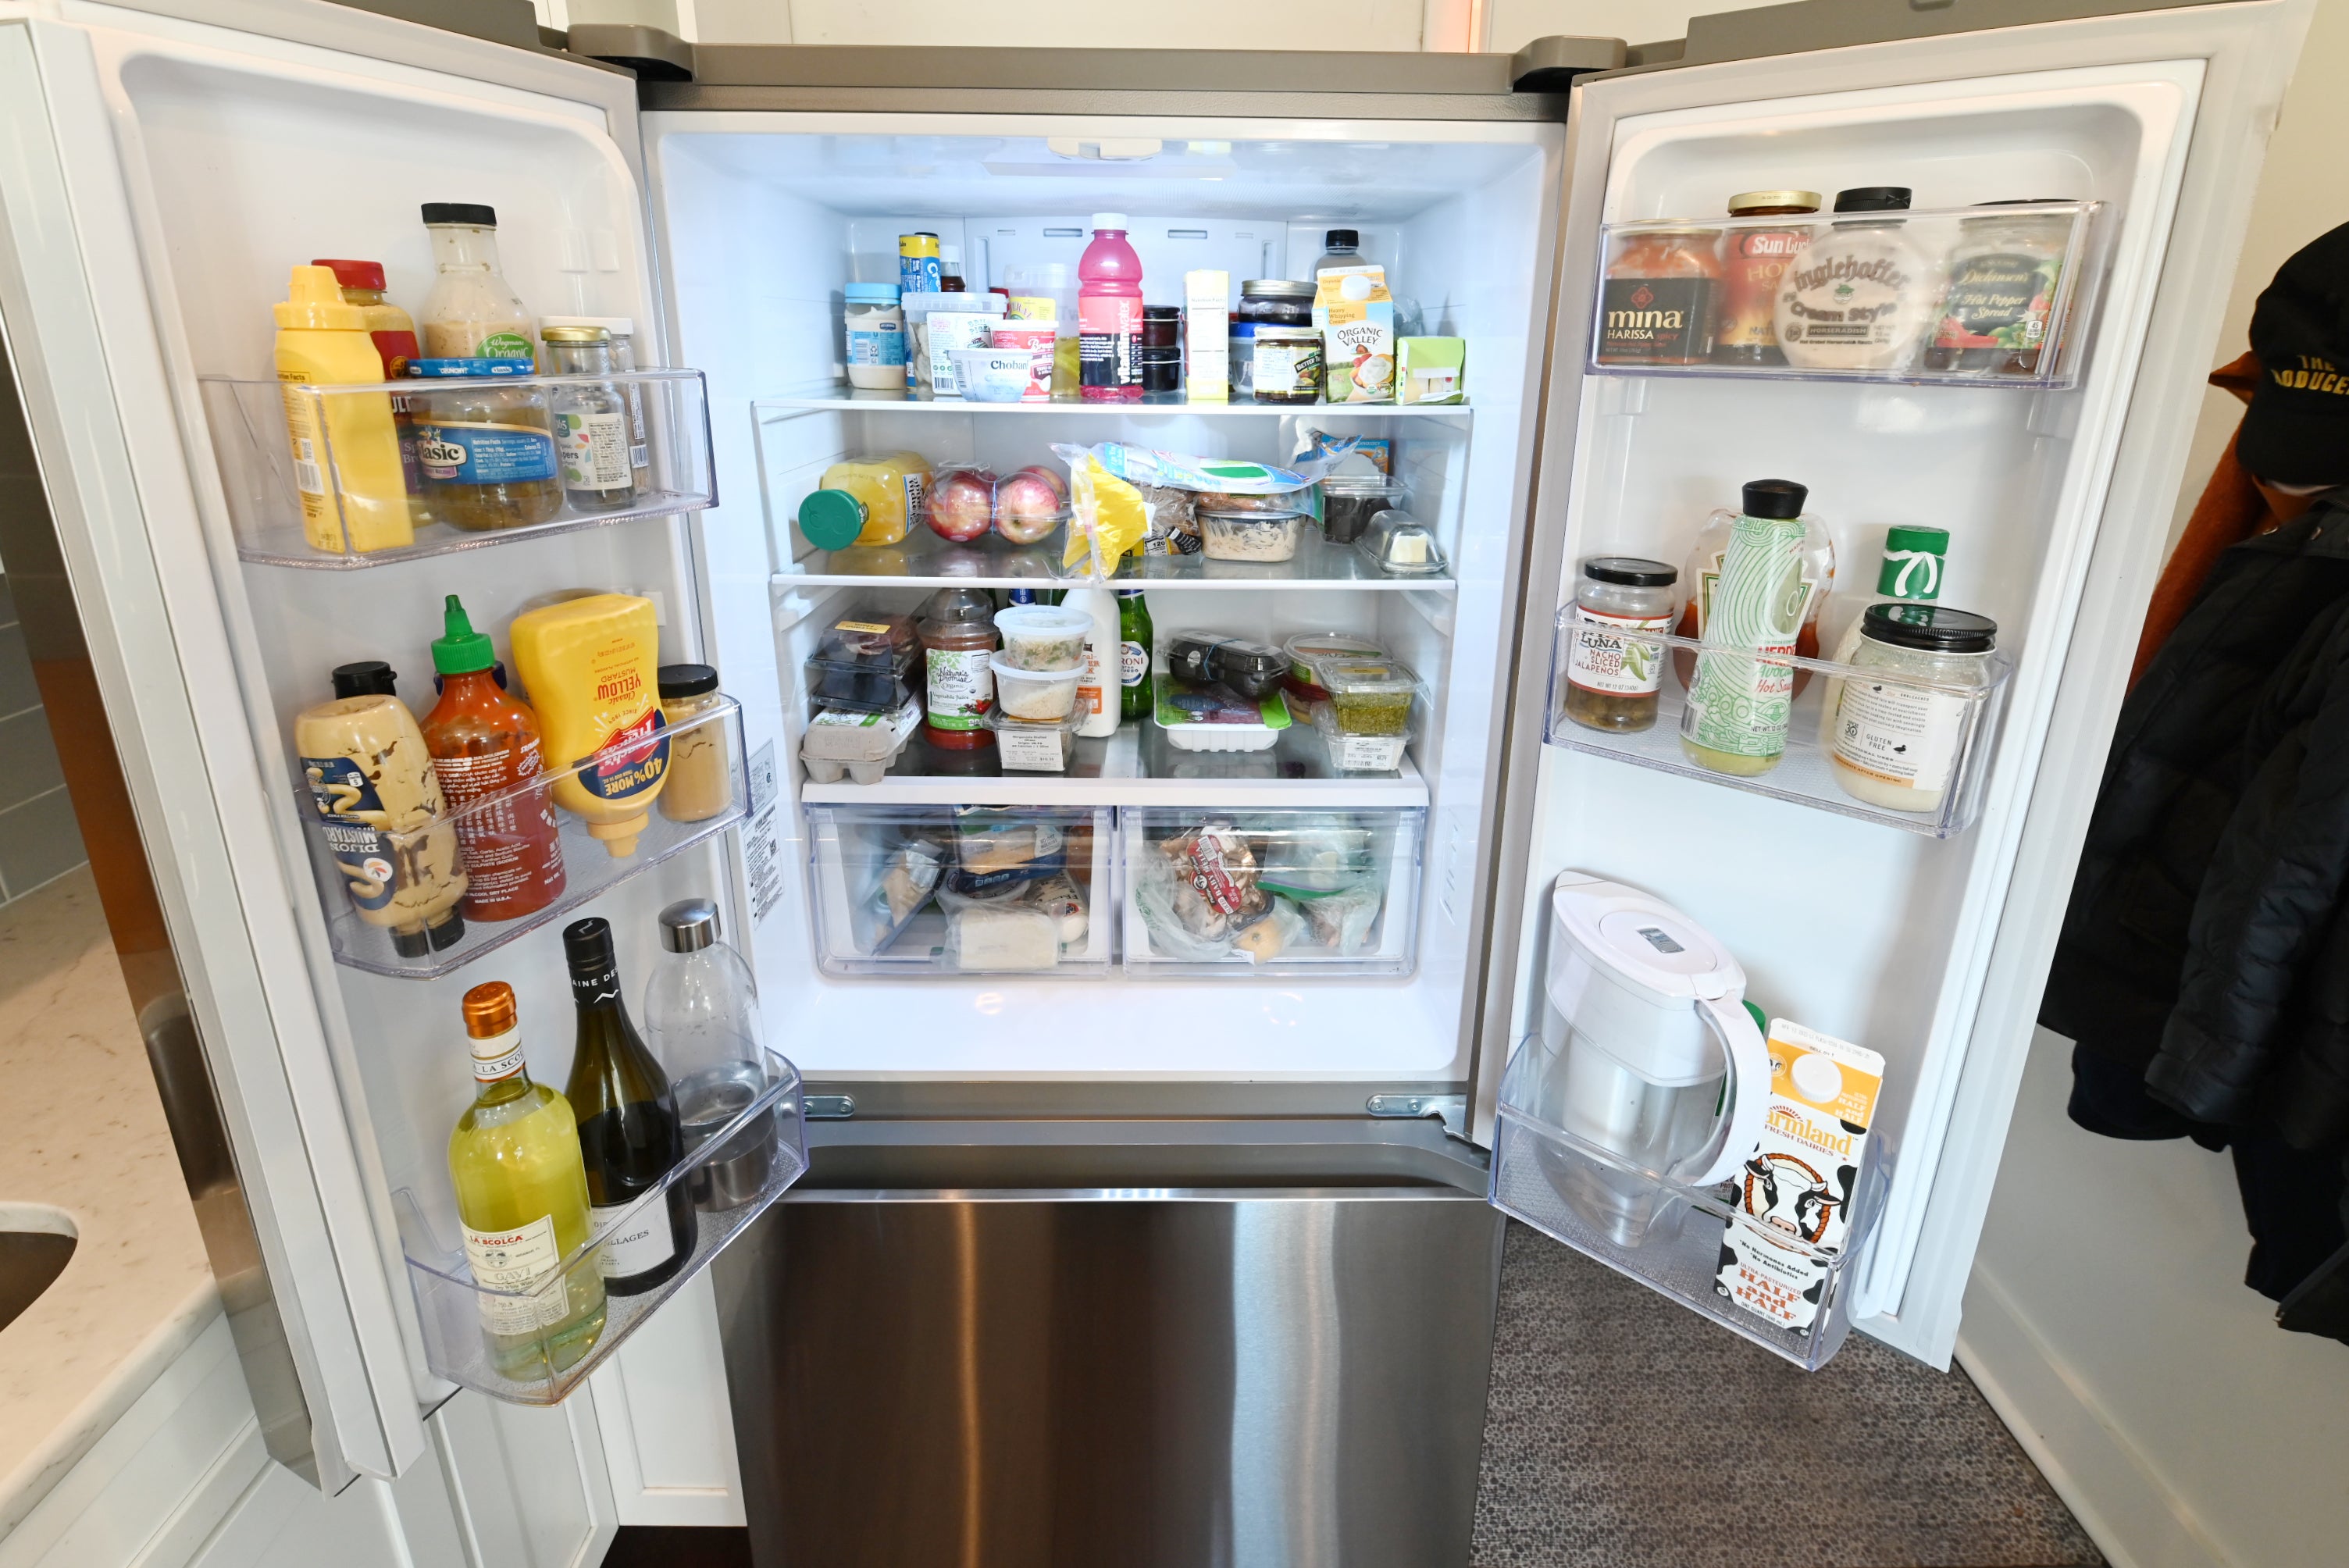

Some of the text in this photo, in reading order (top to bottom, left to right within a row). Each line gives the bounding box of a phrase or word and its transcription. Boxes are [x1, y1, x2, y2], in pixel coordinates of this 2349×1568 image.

[1752, 236, 1784, 254] Sun
[1959, 269, 2030, 285] Dickinson's
[1961, 294, 2026, 306] Hot Pepper
[1608, 310, 1683, 329] mina
[1972, 306, 2013, 320] Spread
[1337, 327, 1383, 340] ORGANIC
[1606, 330, 1679, 341] HARISSA spicy
[491, 337, 524, 349] Wegmans
[1117, 300, 1130, 384] vitaminwater
[1342, 336, 1379, 347] VALLEY
[486, 346, 529, 358] Organic
[1296, 358, 1315, 371] BETTER
[2297, 355, 2336, 372] THE
[422, 444, 461, 461] lasic
[1581, 634, 1622, 649] LUNA
[1590, 650, 1621, 661] NACHO
[1591, 656, 1620, 668] SLICED
[601, 668, 636, 682] MUSTARD
[938, 666, 969, 677] Nature's
[1754, 665, 1794, 679] Avoca
[939, 675, 973, 683] Promise
[1755, 679, 1775, 693] Hot
[597, 673, 641, 700] YELLOW
[608, 690, 636, 705] Classic
[622, 708, 638, 717] SINCE
[1866, 733, 1892, 746] GLUTEN
[1869, 741, 1886, 751] FREE
[605, 757, 663, 796] 40% MORE
[1858, 767, 1902, 783] AFTER OPENING
[330, 843, 381, 853] DIJON
[501, 886, 519, 895] PLACE
[1207, 875, 1223, 897] BABY
[572, 978, 598, 988] AINE
[482, 1064, 497, 1074] LA
[1837, 1097, 1867, 1110] HALF
[1835, 1110, 1864, 1124] HALF
[1845, 1107, 1864, 1117] and
[1764, 1124, 1834, 1156] FRESH DAIRIES
[1766, 1110, 1853, 1156] armland
[483, 1235, 523, 1245] SCOLCA
[608, 1229, 650, 1245] LLAGES
[1752, 1245, 1786, 1267] Hormones
[1787, 1263, 1809, 1278] Added
[494, 1267, 531, 1281] GAVI
[1763, 1259, 1798, 1280] Antibiotics
[1738, 1267, 1801, 1303] HALF
[1740, 1262, 1802, 1295] ULTRA-PASTEURIZED
[1735, 1285, 1797, 1322] HALF
[1745, 1285, 1788, 1310] and
[1750, 1305, 1766, 1317] QUART
